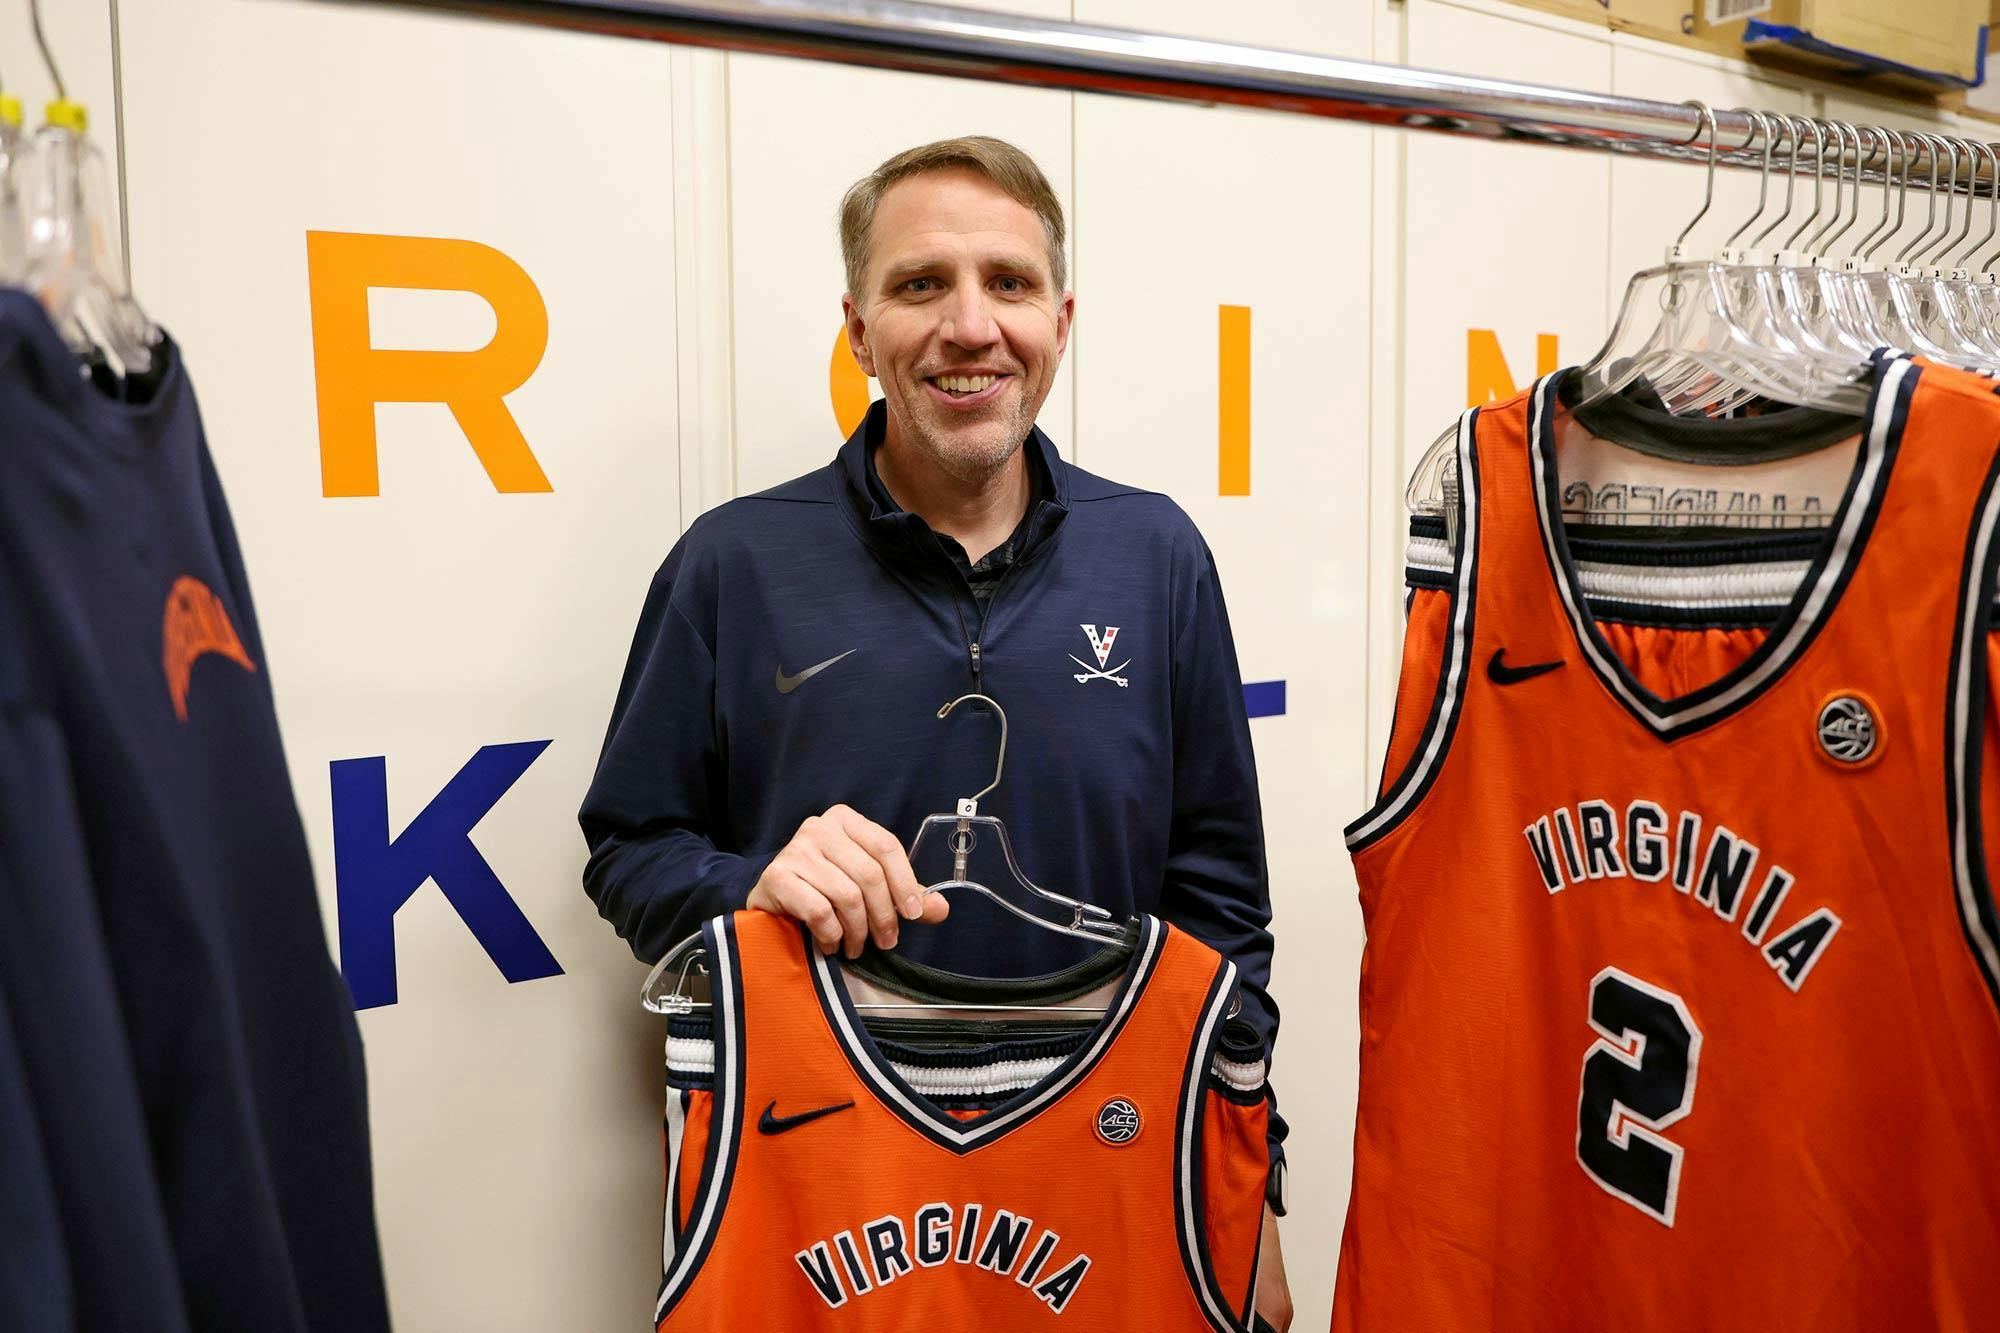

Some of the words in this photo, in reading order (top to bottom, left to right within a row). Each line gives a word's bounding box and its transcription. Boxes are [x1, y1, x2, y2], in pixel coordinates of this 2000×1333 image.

[306, 230, 555, 498] R
[329, 739, 566, 1012] K
[1524, 798, 1843, 993] VIRGINIA
[1102, 1113, 1138, 1125] ACC
[1576, 965, 1704, 1229] 2
[794, 1201, 1093, 1316] VIRGINIA
